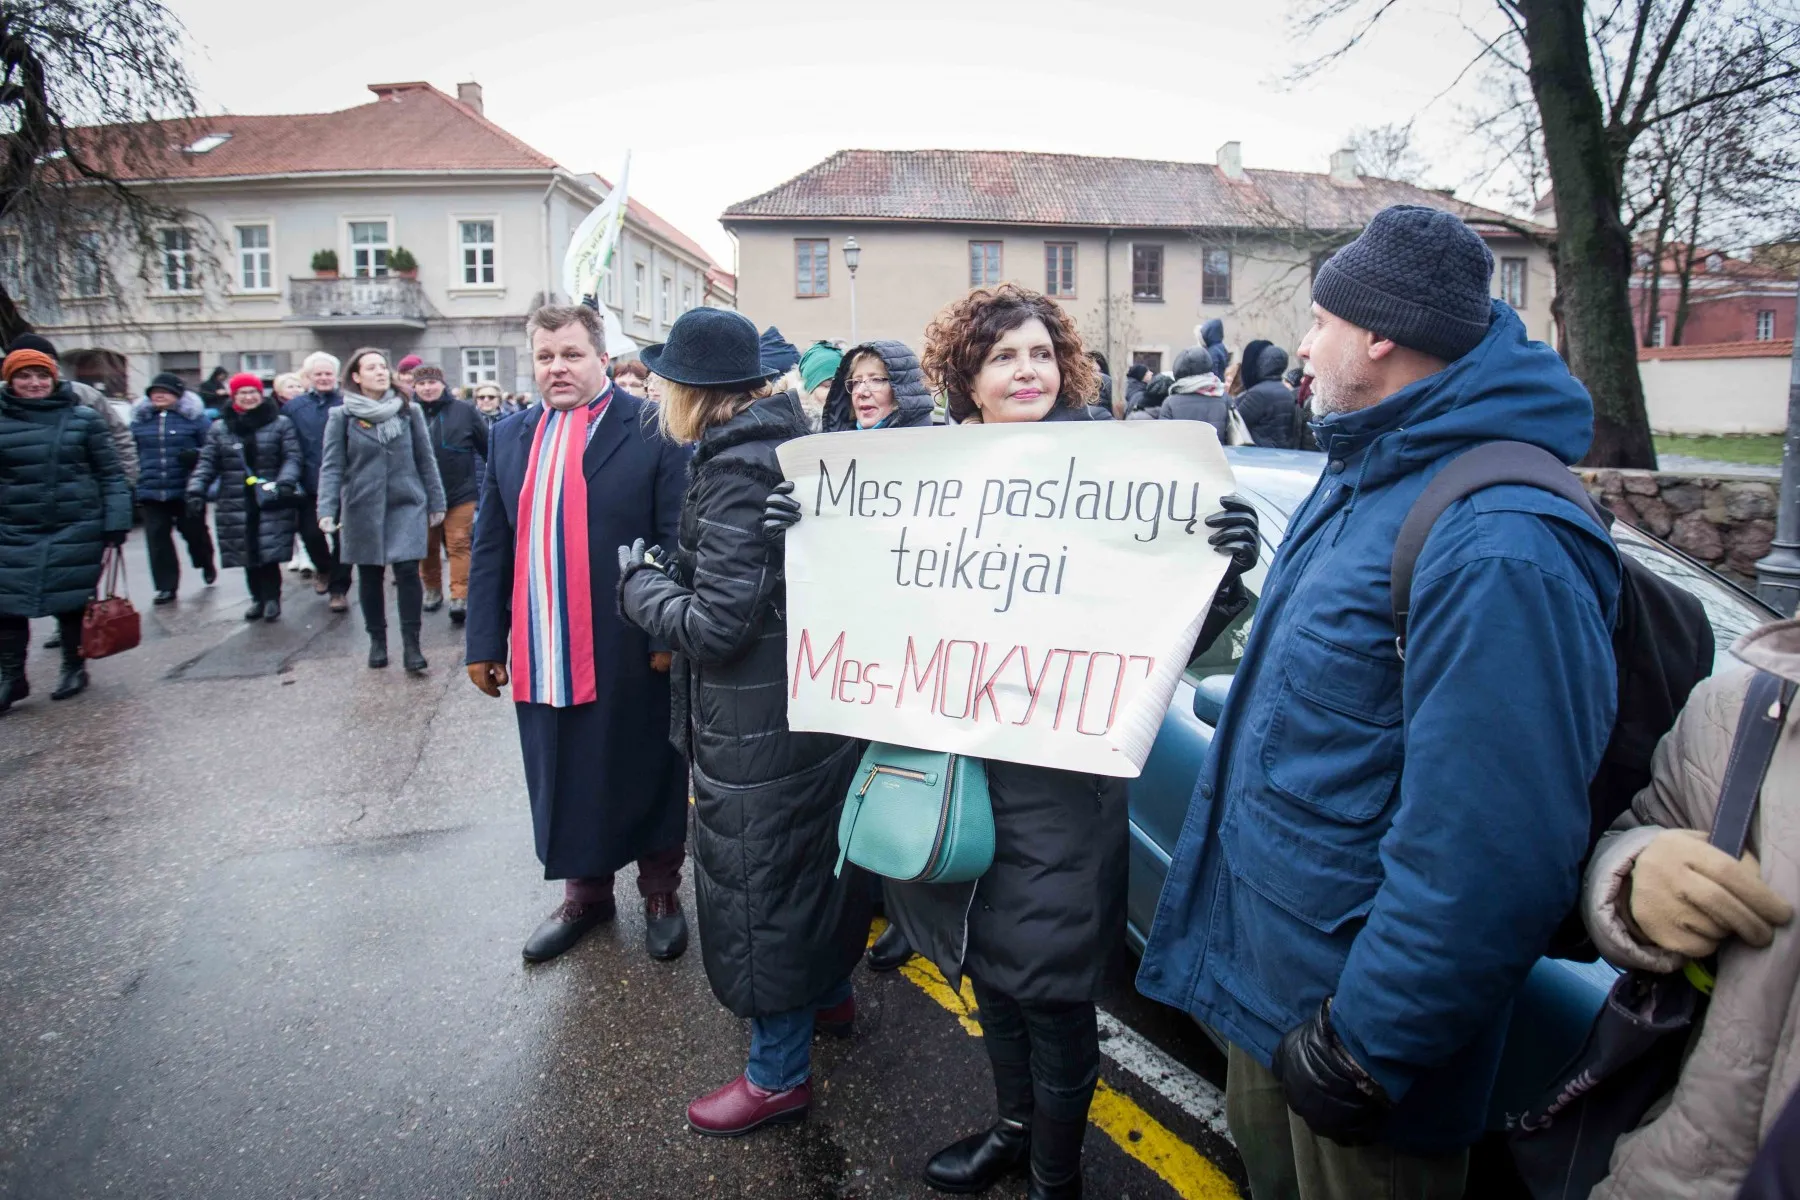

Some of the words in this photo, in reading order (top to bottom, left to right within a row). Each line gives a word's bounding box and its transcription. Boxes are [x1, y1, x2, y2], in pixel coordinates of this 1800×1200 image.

[814, 458, 902, 518] Mes
[912, 479, 963, 517] ne
[975, 456, 1200, 543] paslaugų
[890, 526, 1068, 613] teikėjai
